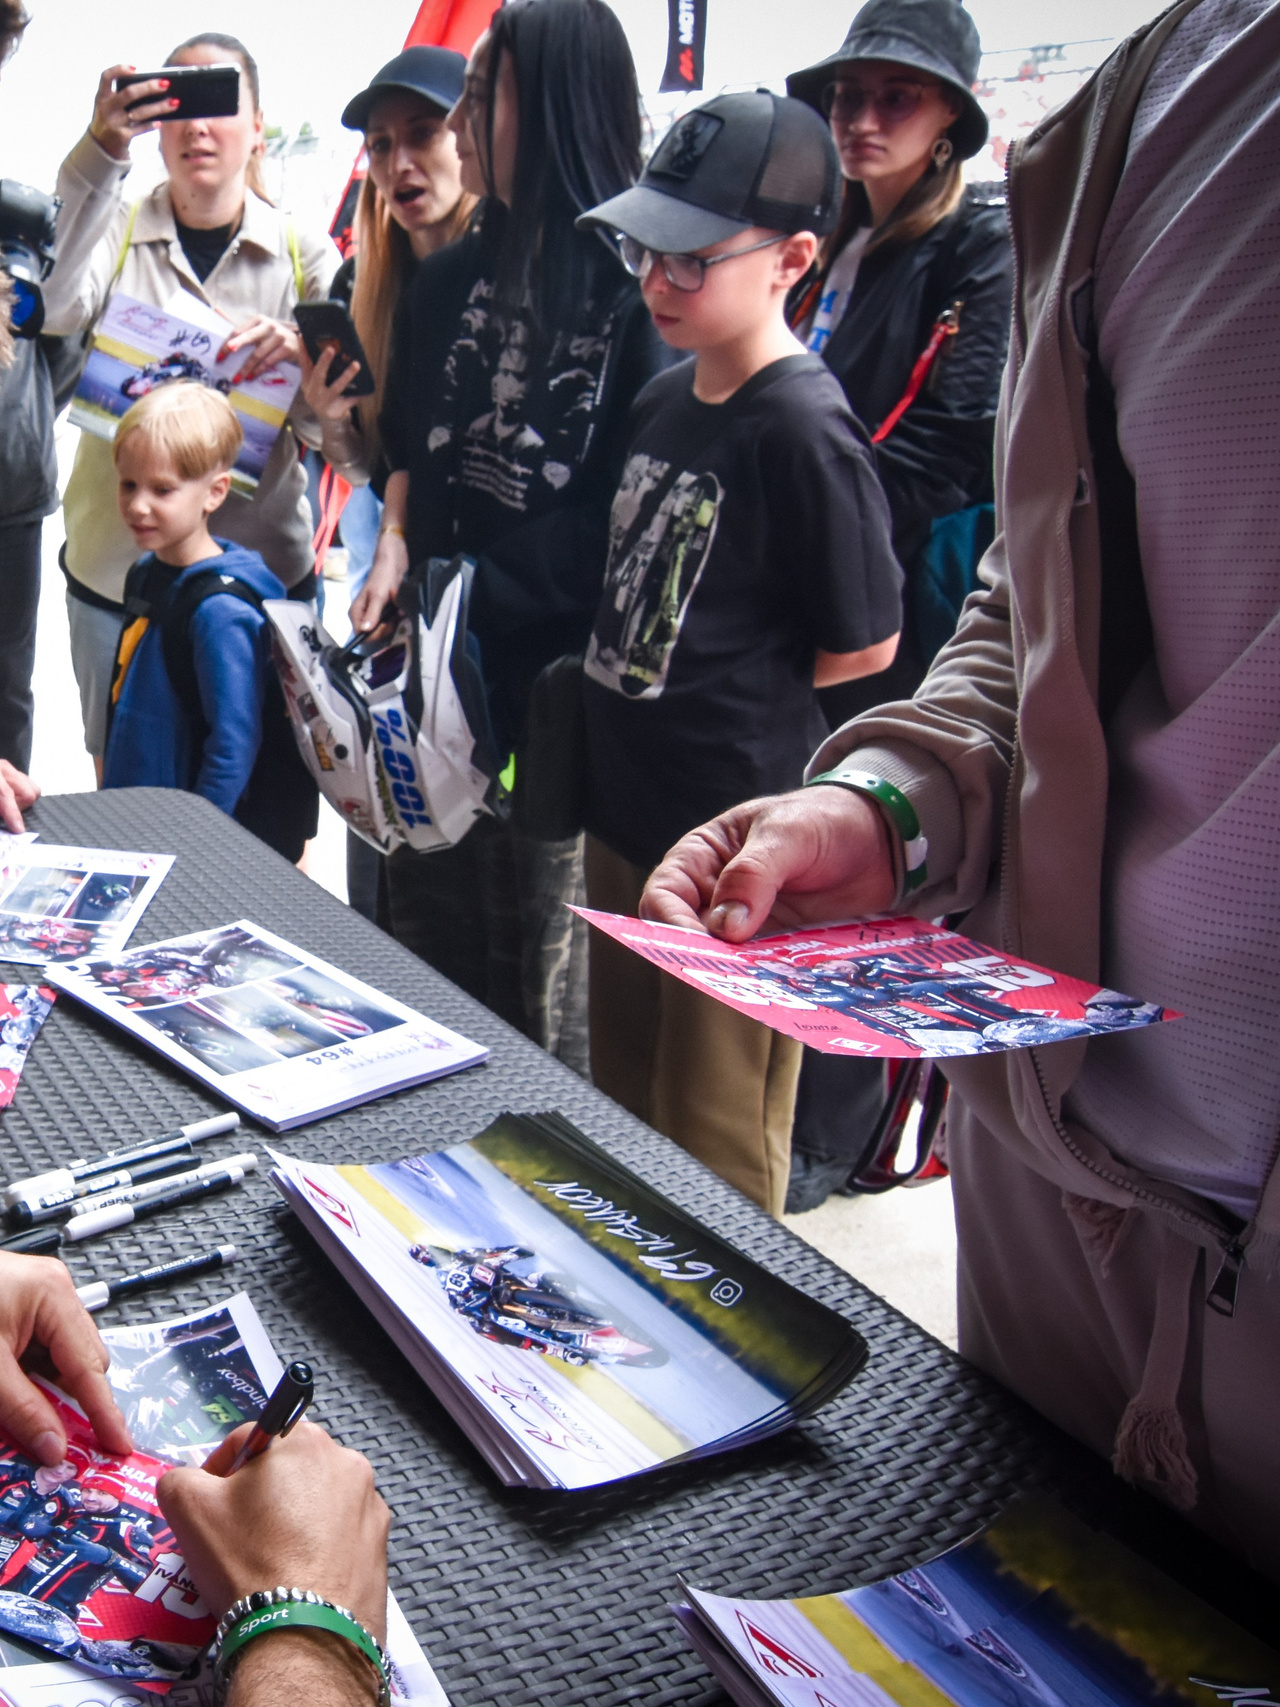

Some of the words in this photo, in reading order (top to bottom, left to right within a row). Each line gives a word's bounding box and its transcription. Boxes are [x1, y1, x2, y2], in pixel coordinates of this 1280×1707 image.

[372, 708, 432, 829] 100%
[941, 955, 1056, 992] 15
[238, 1608, 290, 1638] Sport
